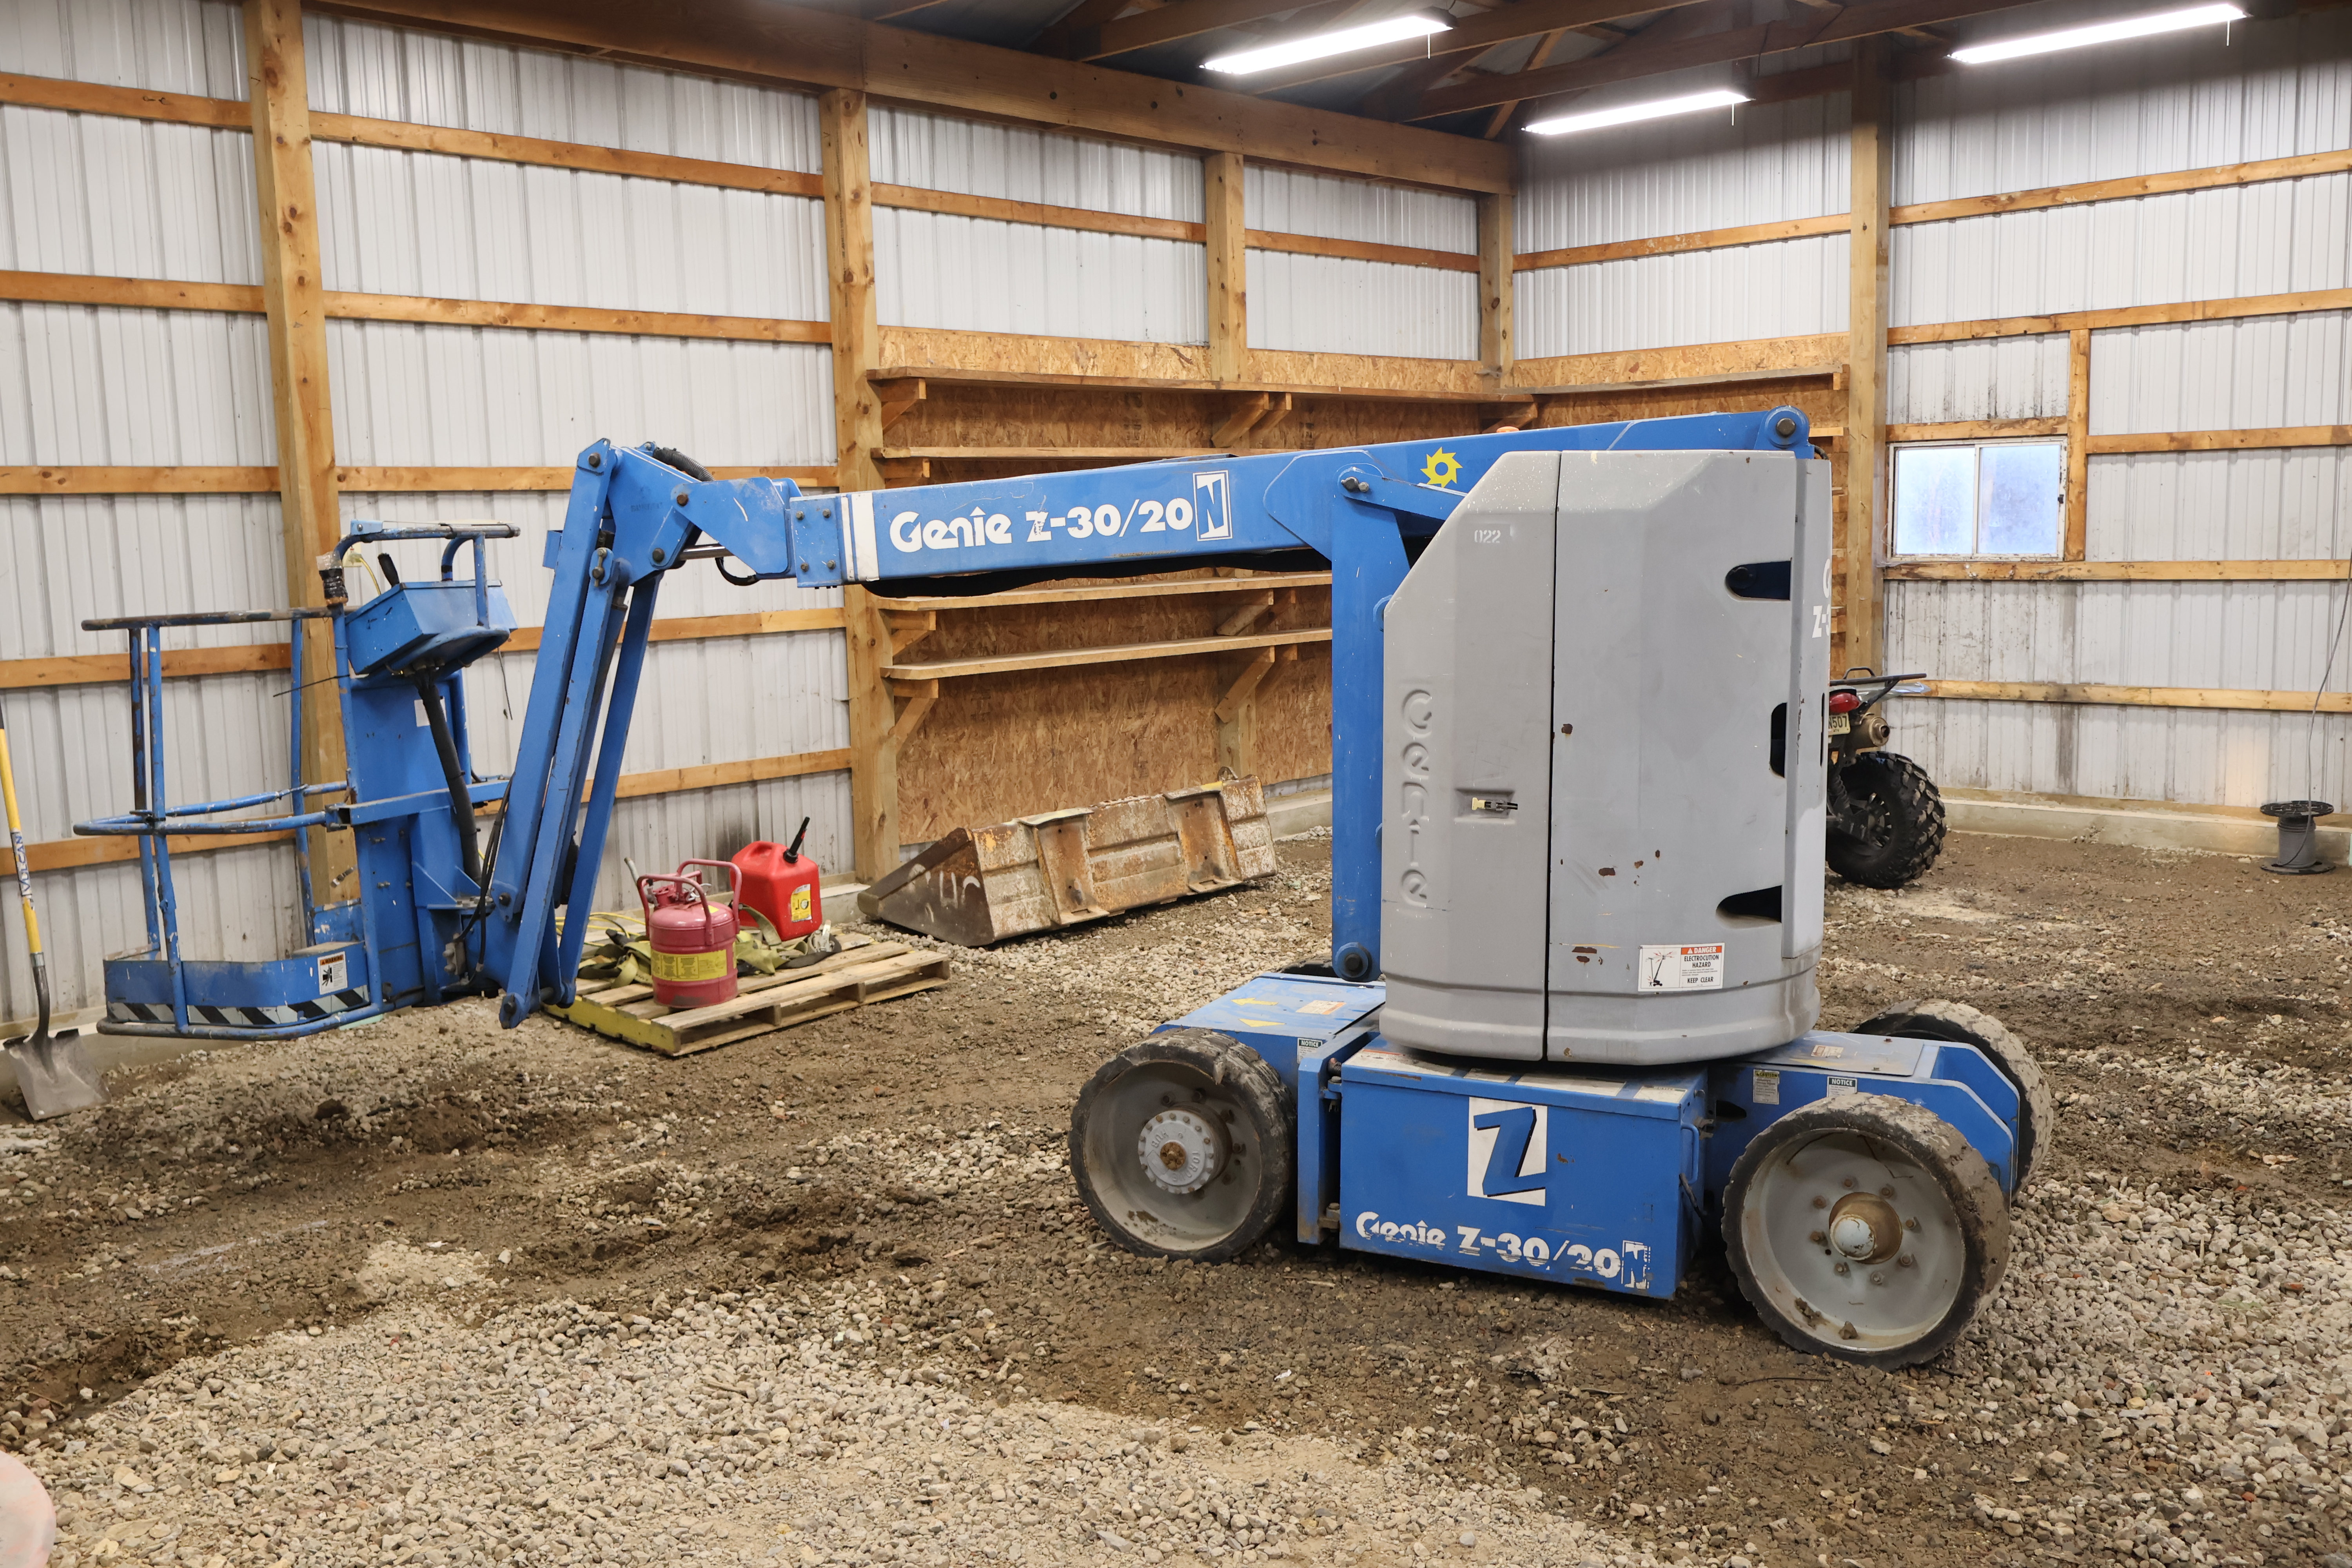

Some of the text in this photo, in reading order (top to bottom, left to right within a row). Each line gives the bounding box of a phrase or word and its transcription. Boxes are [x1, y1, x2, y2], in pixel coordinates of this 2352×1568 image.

[889, 506, 1013, 553] Genie
[1474, 529, 1501, 543] 022
[1401, 689, 1433, 908] Genie
[15, 835, 31, 892] VULCAN
[1831, 1078, 1853, 1087] NOTICE
[1356, 1211, 1446, 1250] Genie
